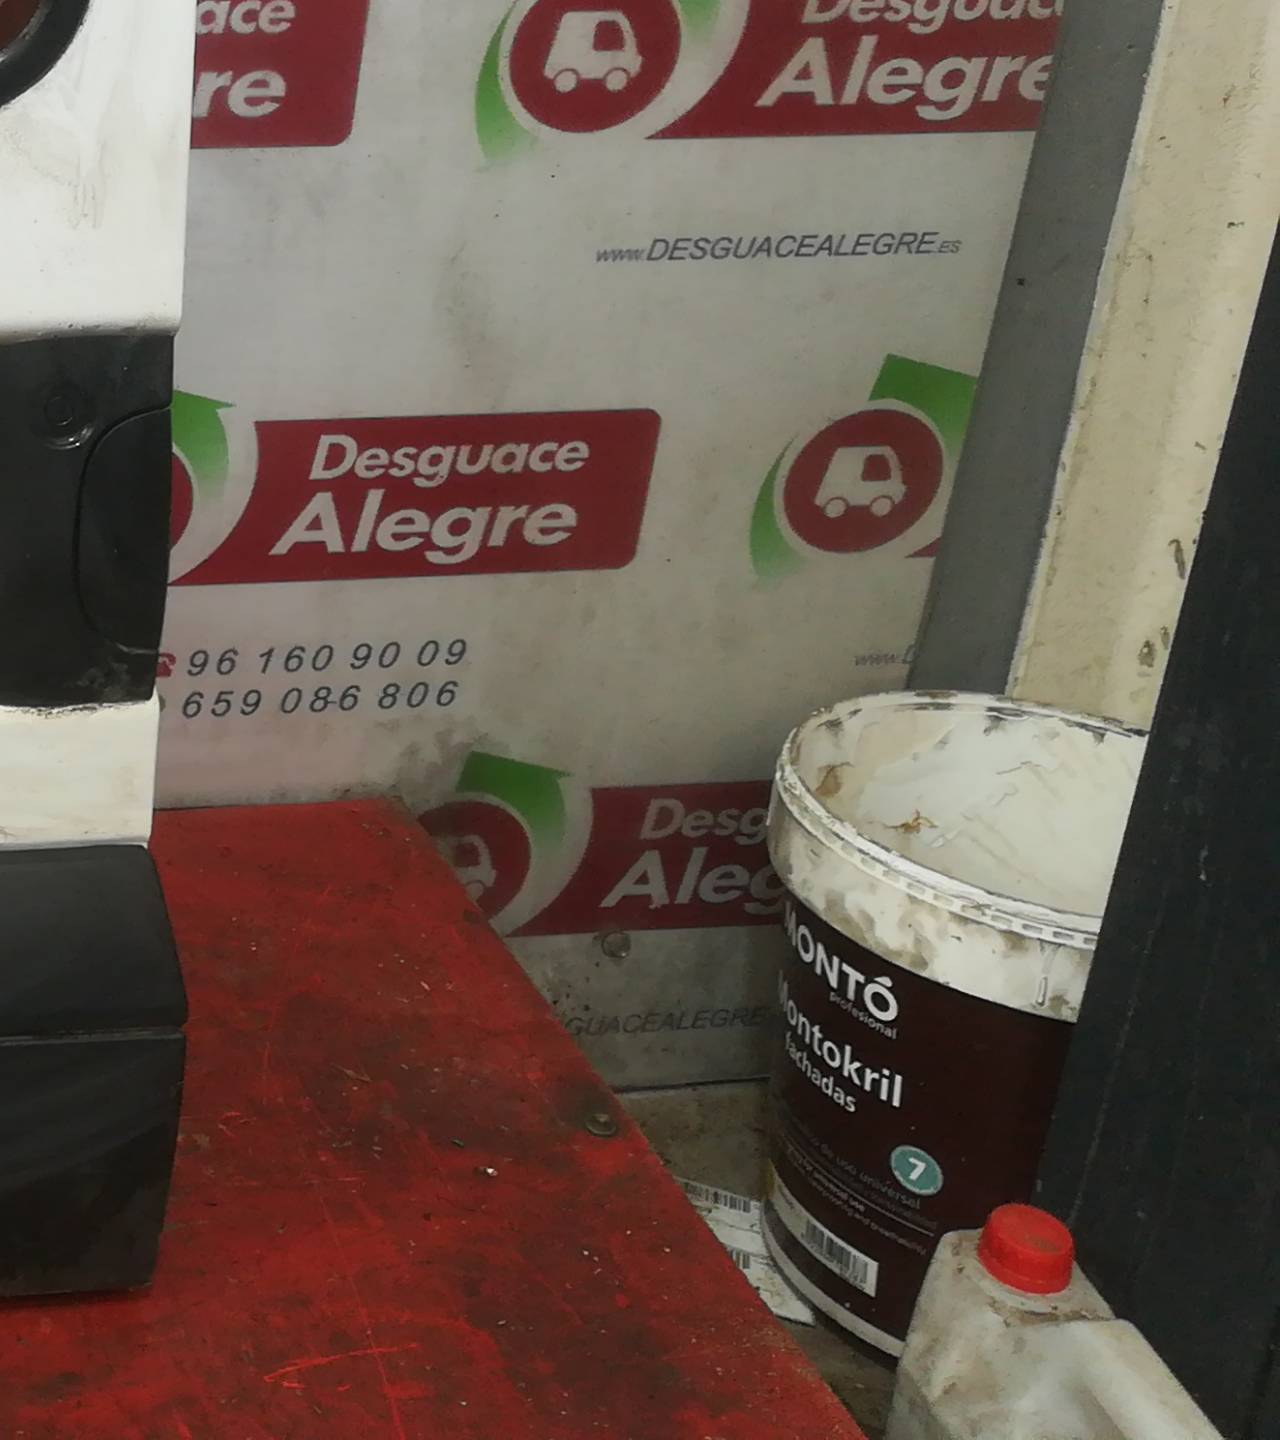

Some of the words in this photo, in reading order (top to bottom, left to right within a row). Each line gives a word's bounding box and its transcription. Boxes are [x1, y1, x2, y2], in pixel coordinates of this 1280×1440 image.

[309, 433, 590, 488] Desguace
[268, 489, 579, 565] Alegre
[186, 647, 239, 677] 96
[258, 644, 335, 675] 160
[350, 641, 401, 671] 90
[416, 638, 468, 667] 09
[181, 688, 263, 719] 659
[280, 684, 361, 715] 086
[377, 679, 460, 710] 806
[639, 798, 768, 845] Desg
[598, 847, 786, 914] Aleg
[779, 968, 904, 1108] Montokril
[785, 1031, 857, 1113] fachadas
